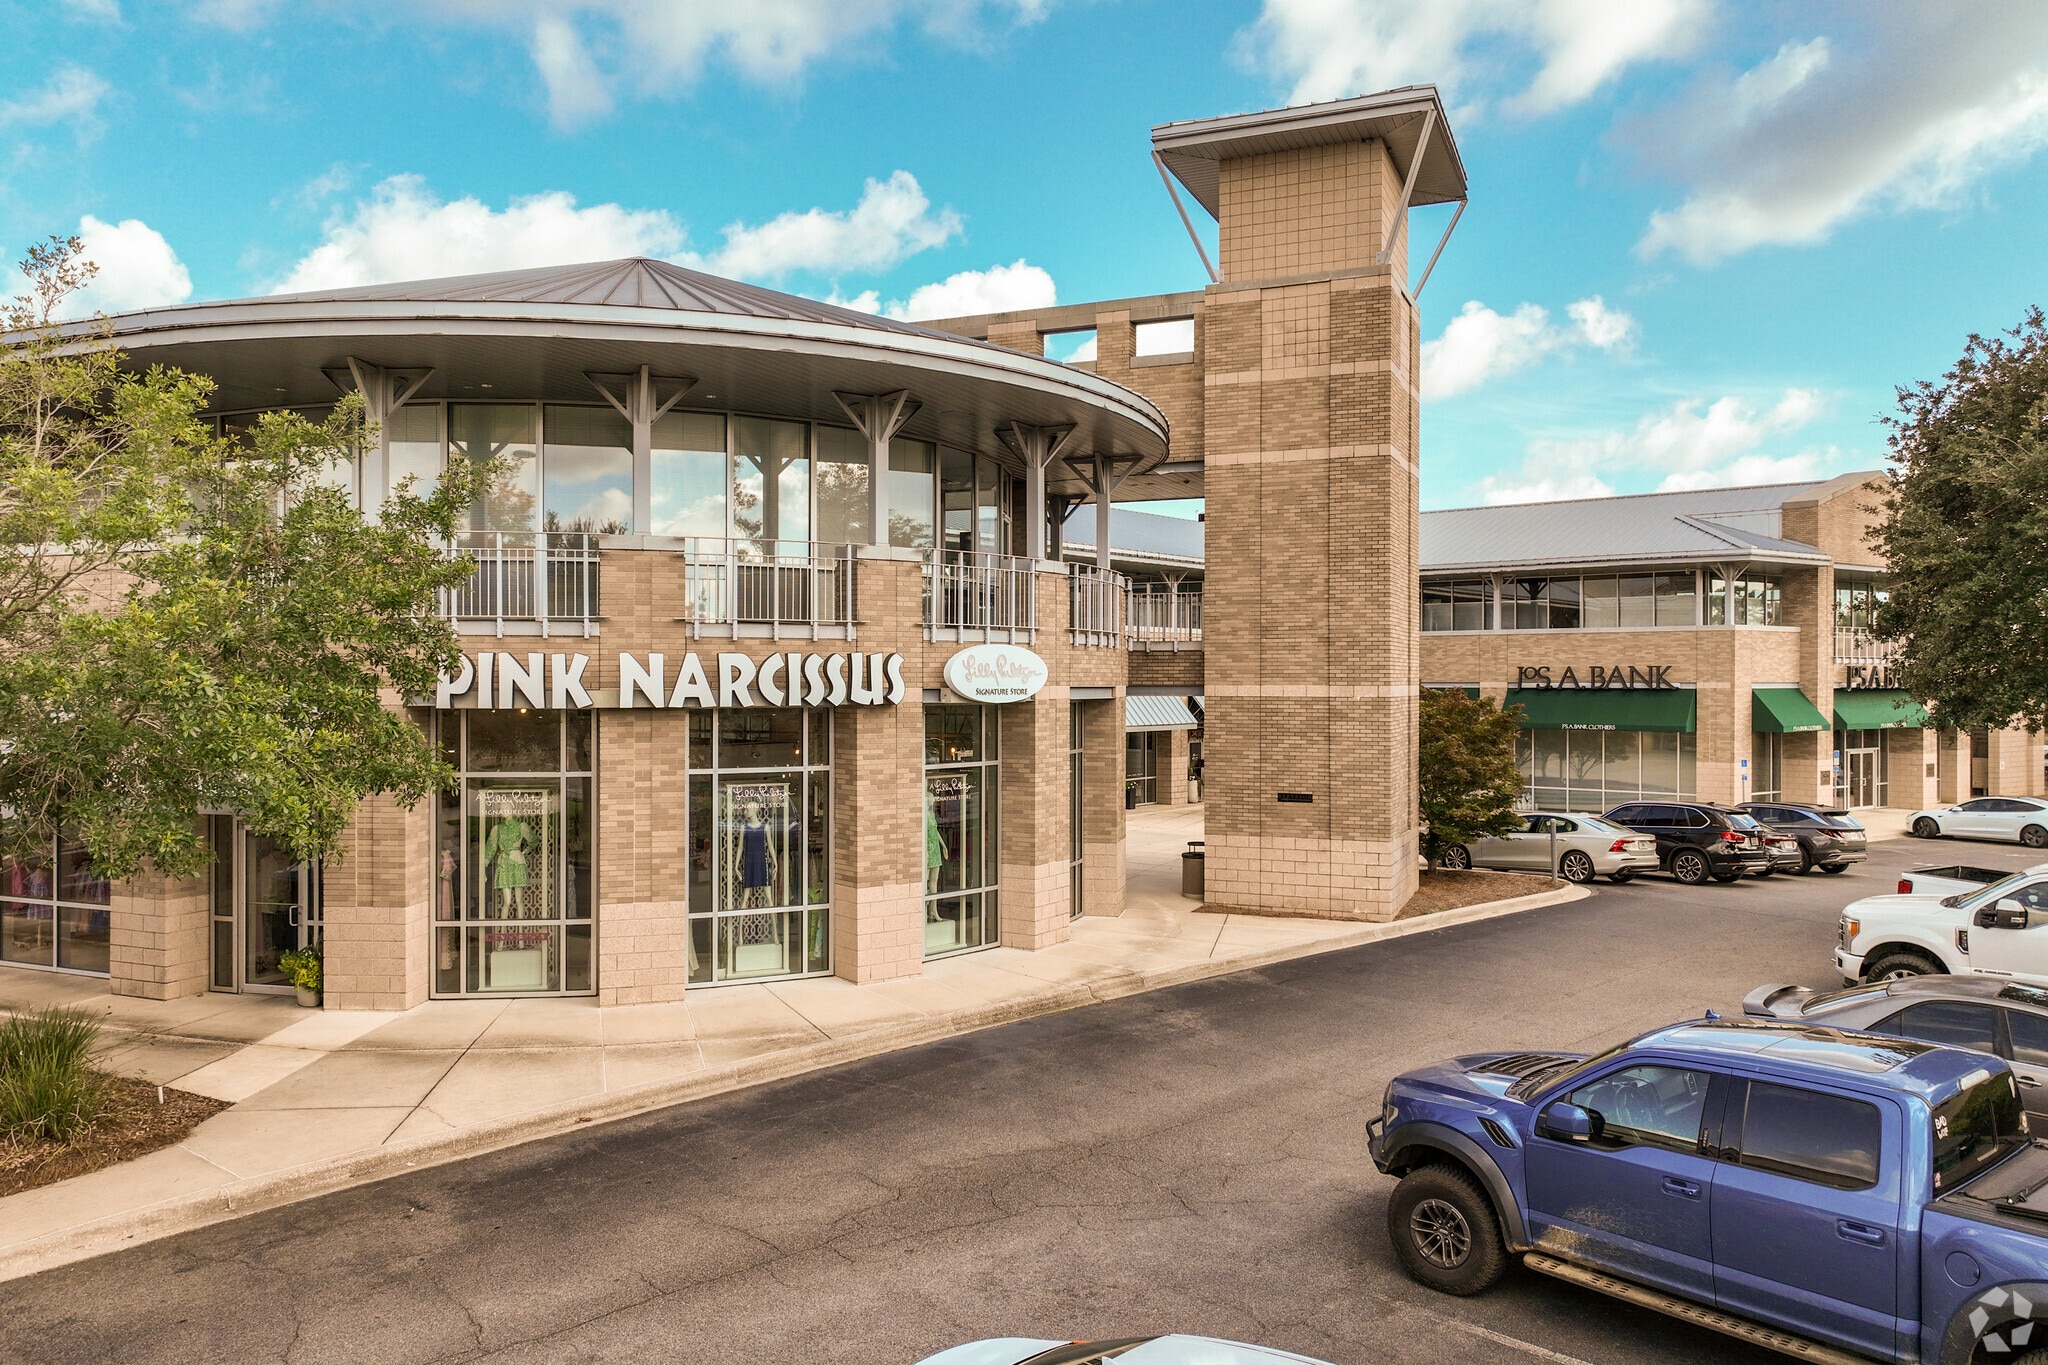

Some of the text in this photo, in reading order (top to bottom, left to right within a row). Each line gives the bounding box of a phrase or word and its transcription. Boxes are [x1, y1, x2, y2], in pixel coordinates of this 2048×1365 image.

[436, 652, 906, 709] PINK NARCISSUS
[962, 654, 1000, 687] Lilly
[1589, 666, 1679, 690] BANK
[975, 688, 1009, 696] SIGNATURE
[484, 790, 515, 808] Lilly
[733, 785, 762, 802] Lilly
